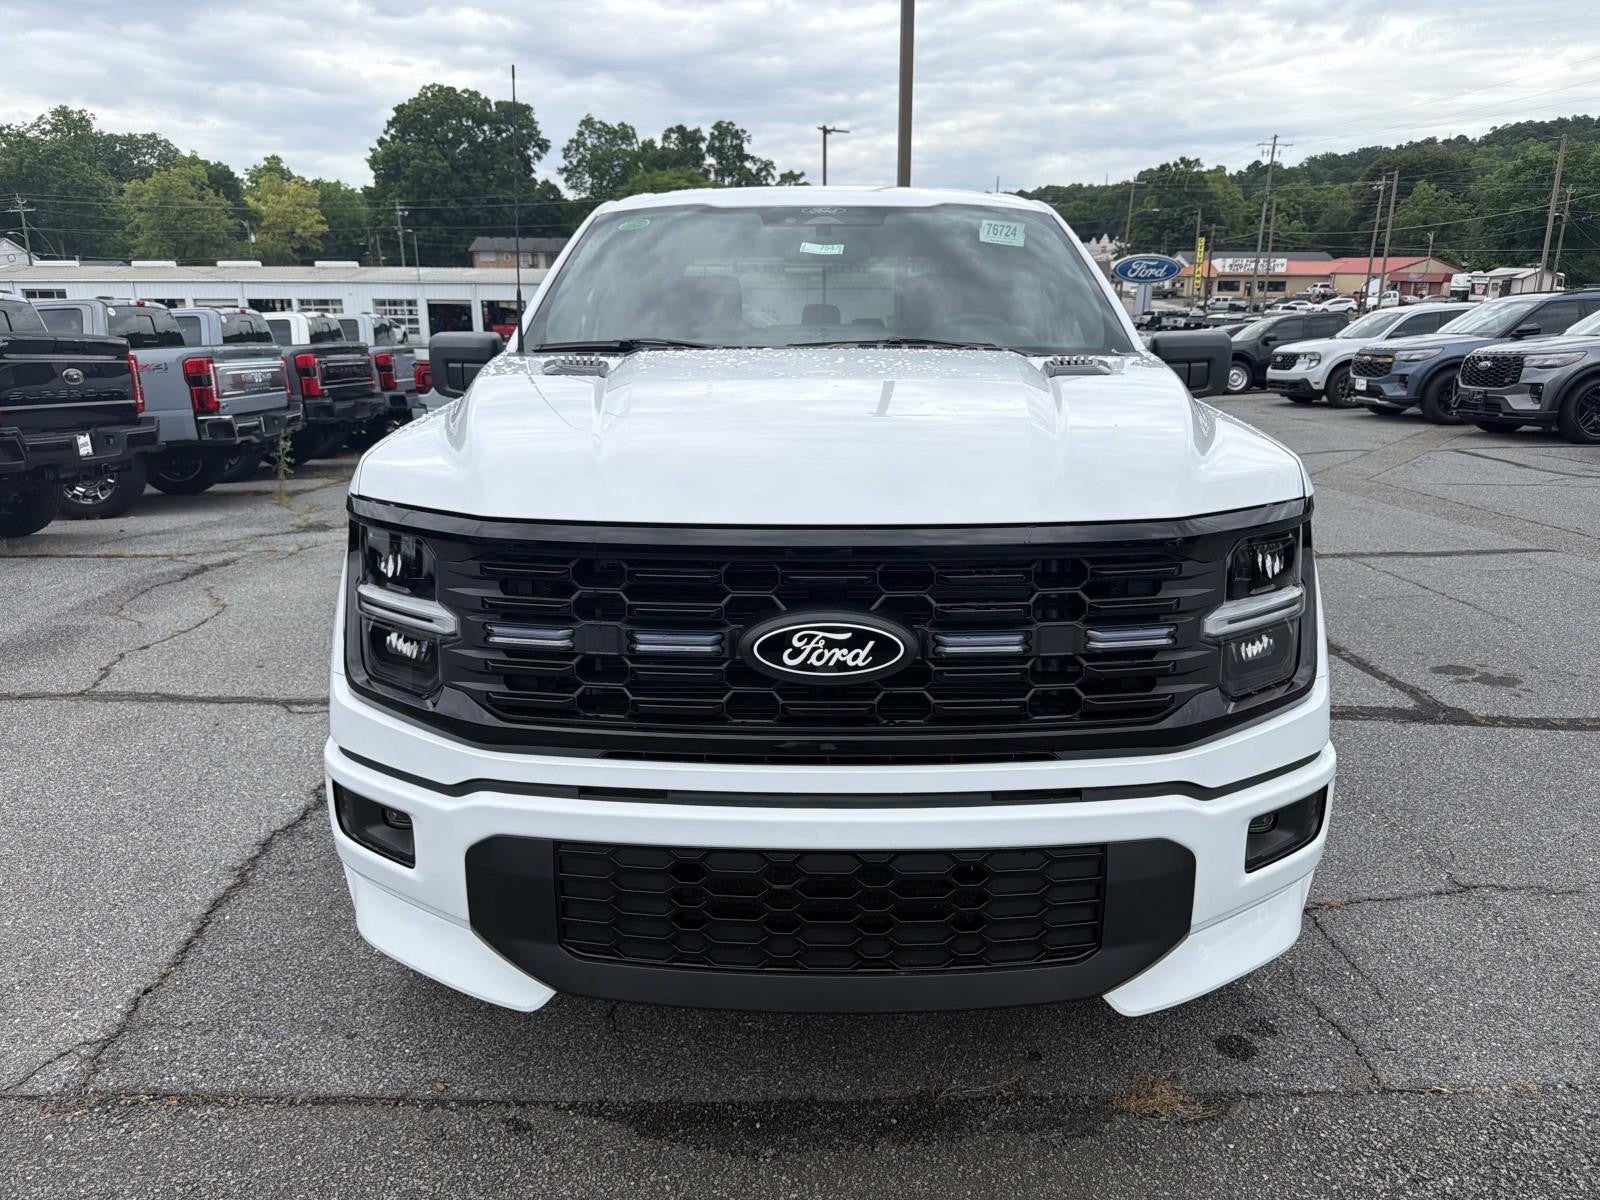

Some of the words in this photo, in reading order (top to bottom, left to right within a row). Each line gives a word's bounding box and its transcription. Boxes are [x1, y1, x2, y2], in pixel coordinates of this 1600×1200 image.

[986, 223, 1018, 239] 76724
[1127, 260, 1168, 278] Ford
[782, 630, 876, 667] Ford
